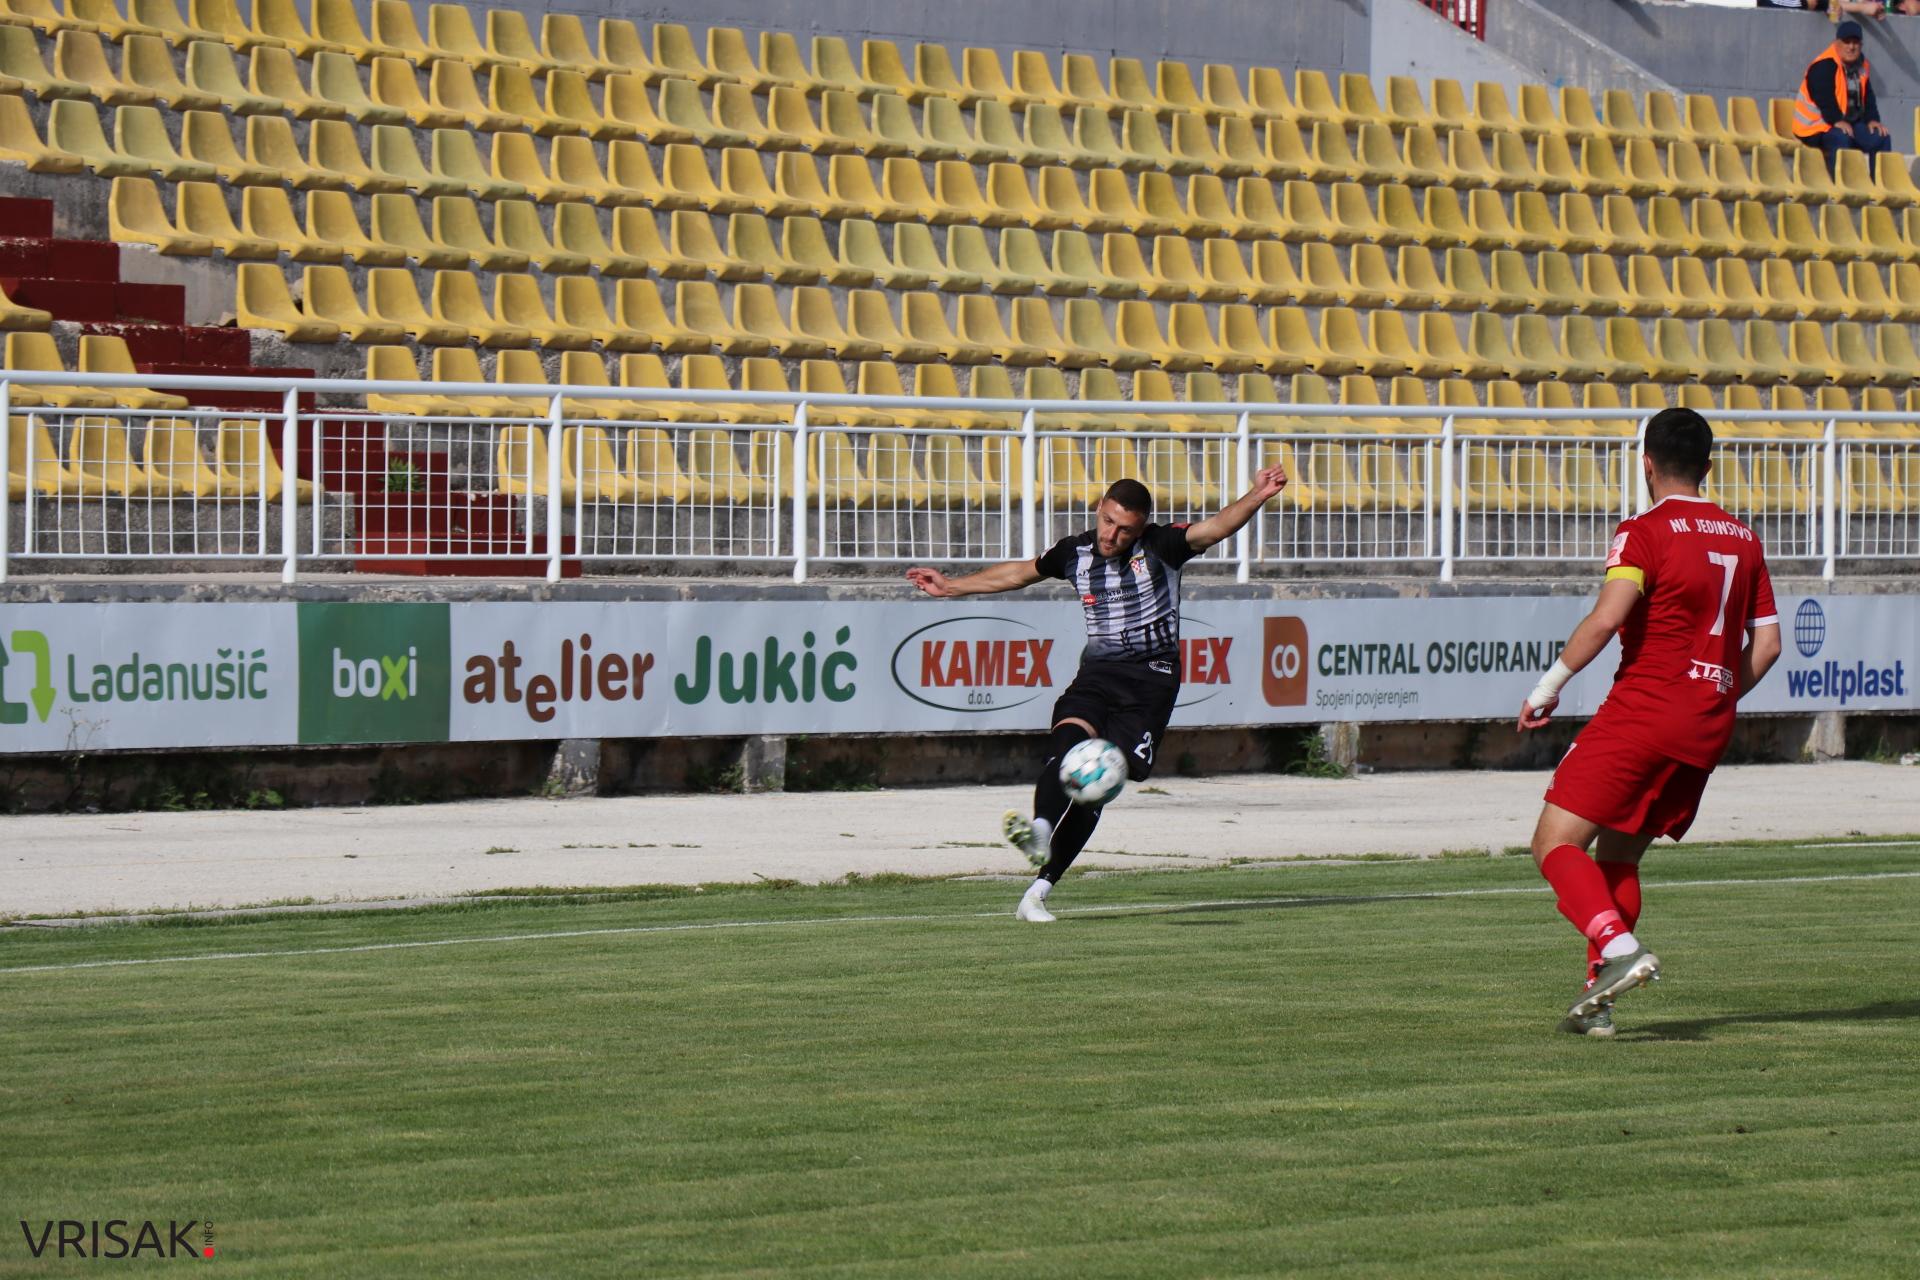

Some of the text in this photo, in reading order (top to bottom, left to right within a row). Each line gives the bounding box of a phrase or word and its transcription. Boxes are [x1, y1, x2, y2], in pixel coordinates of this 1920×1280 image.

[1669, 518, 1753, 541] NK JEDINSTVO
[1707, 551, 1738, 636] 7
[67, 648, 268, 702] Ladanušić
[333, 646, 417, 700] boxi
[463, 625, 857, 723] atelier Jukić
[921, 639, 1054, 687] KAMEX
[1318, 643, 1420, 677] CENTRAL
[1787, 660, 1904, 705] weltplast
[968, 689, 994, 705] d.o.o.
[1315, 688, 1419, 709] Spojeni povjerenjem
